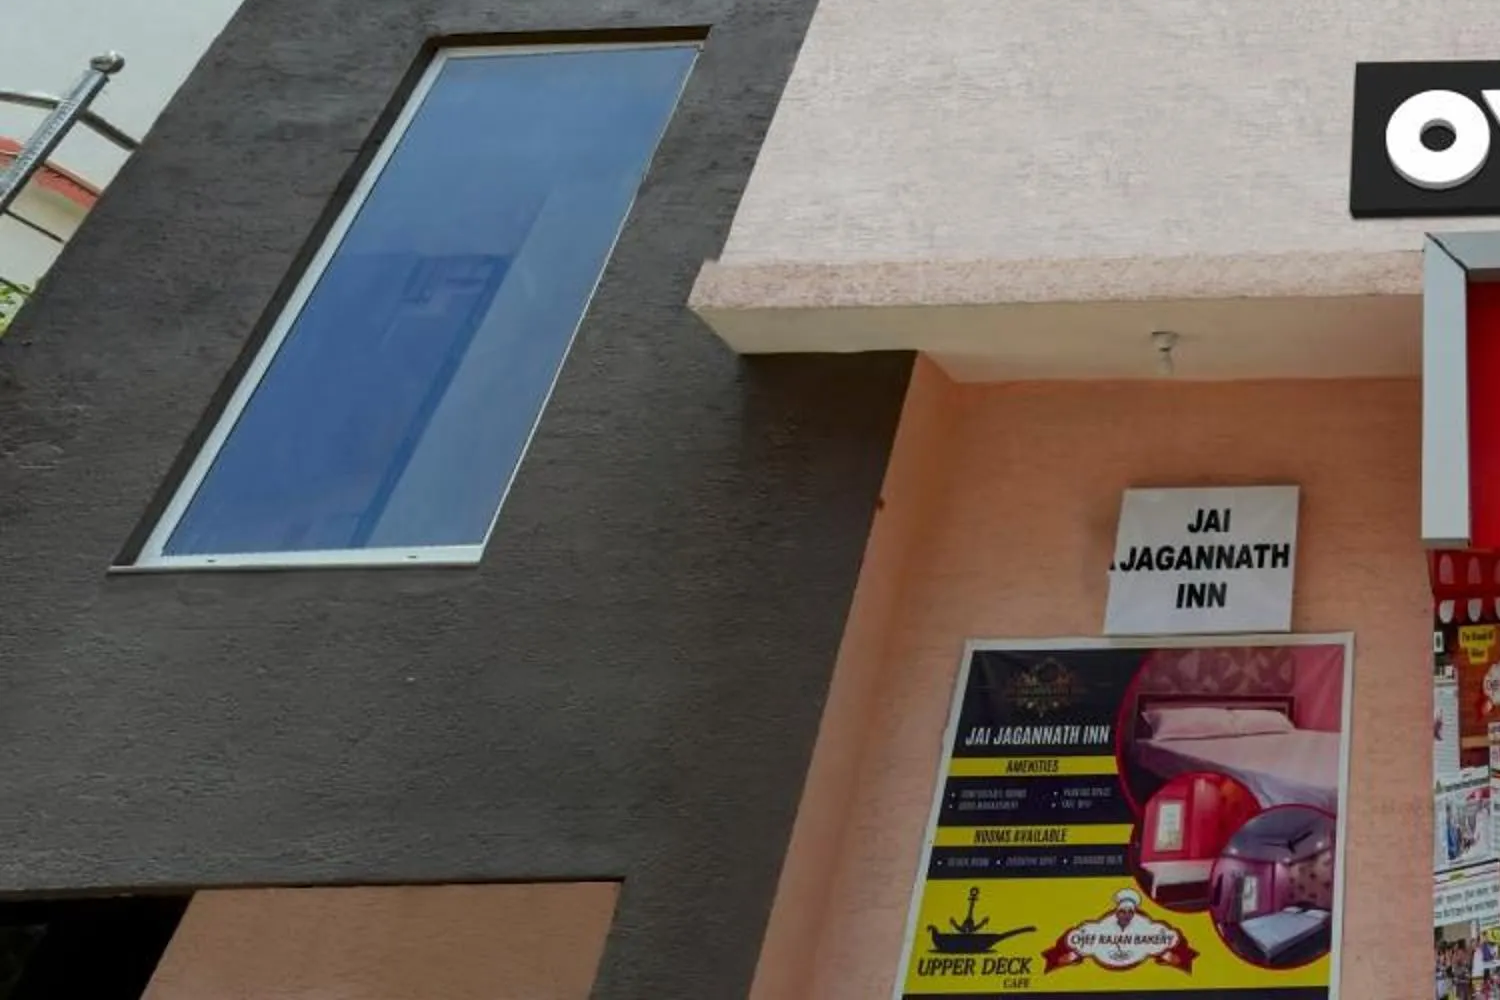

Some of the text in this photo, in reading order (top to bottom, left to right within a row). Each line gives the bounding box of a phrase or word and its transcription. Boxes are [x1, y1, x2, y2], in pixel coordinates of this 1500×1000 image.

[1187, 508, 1231, 534] JAI
[1119, 543, 1291, 572] JAGANNATH
[1175, 582, 1228, 609] INN
[965, 724, 1111, 746] JAI JAGANNATH INN
[1069, 934, 1096, 948] CHEF
[918, 956, 1034, 977] UPPER DECK
